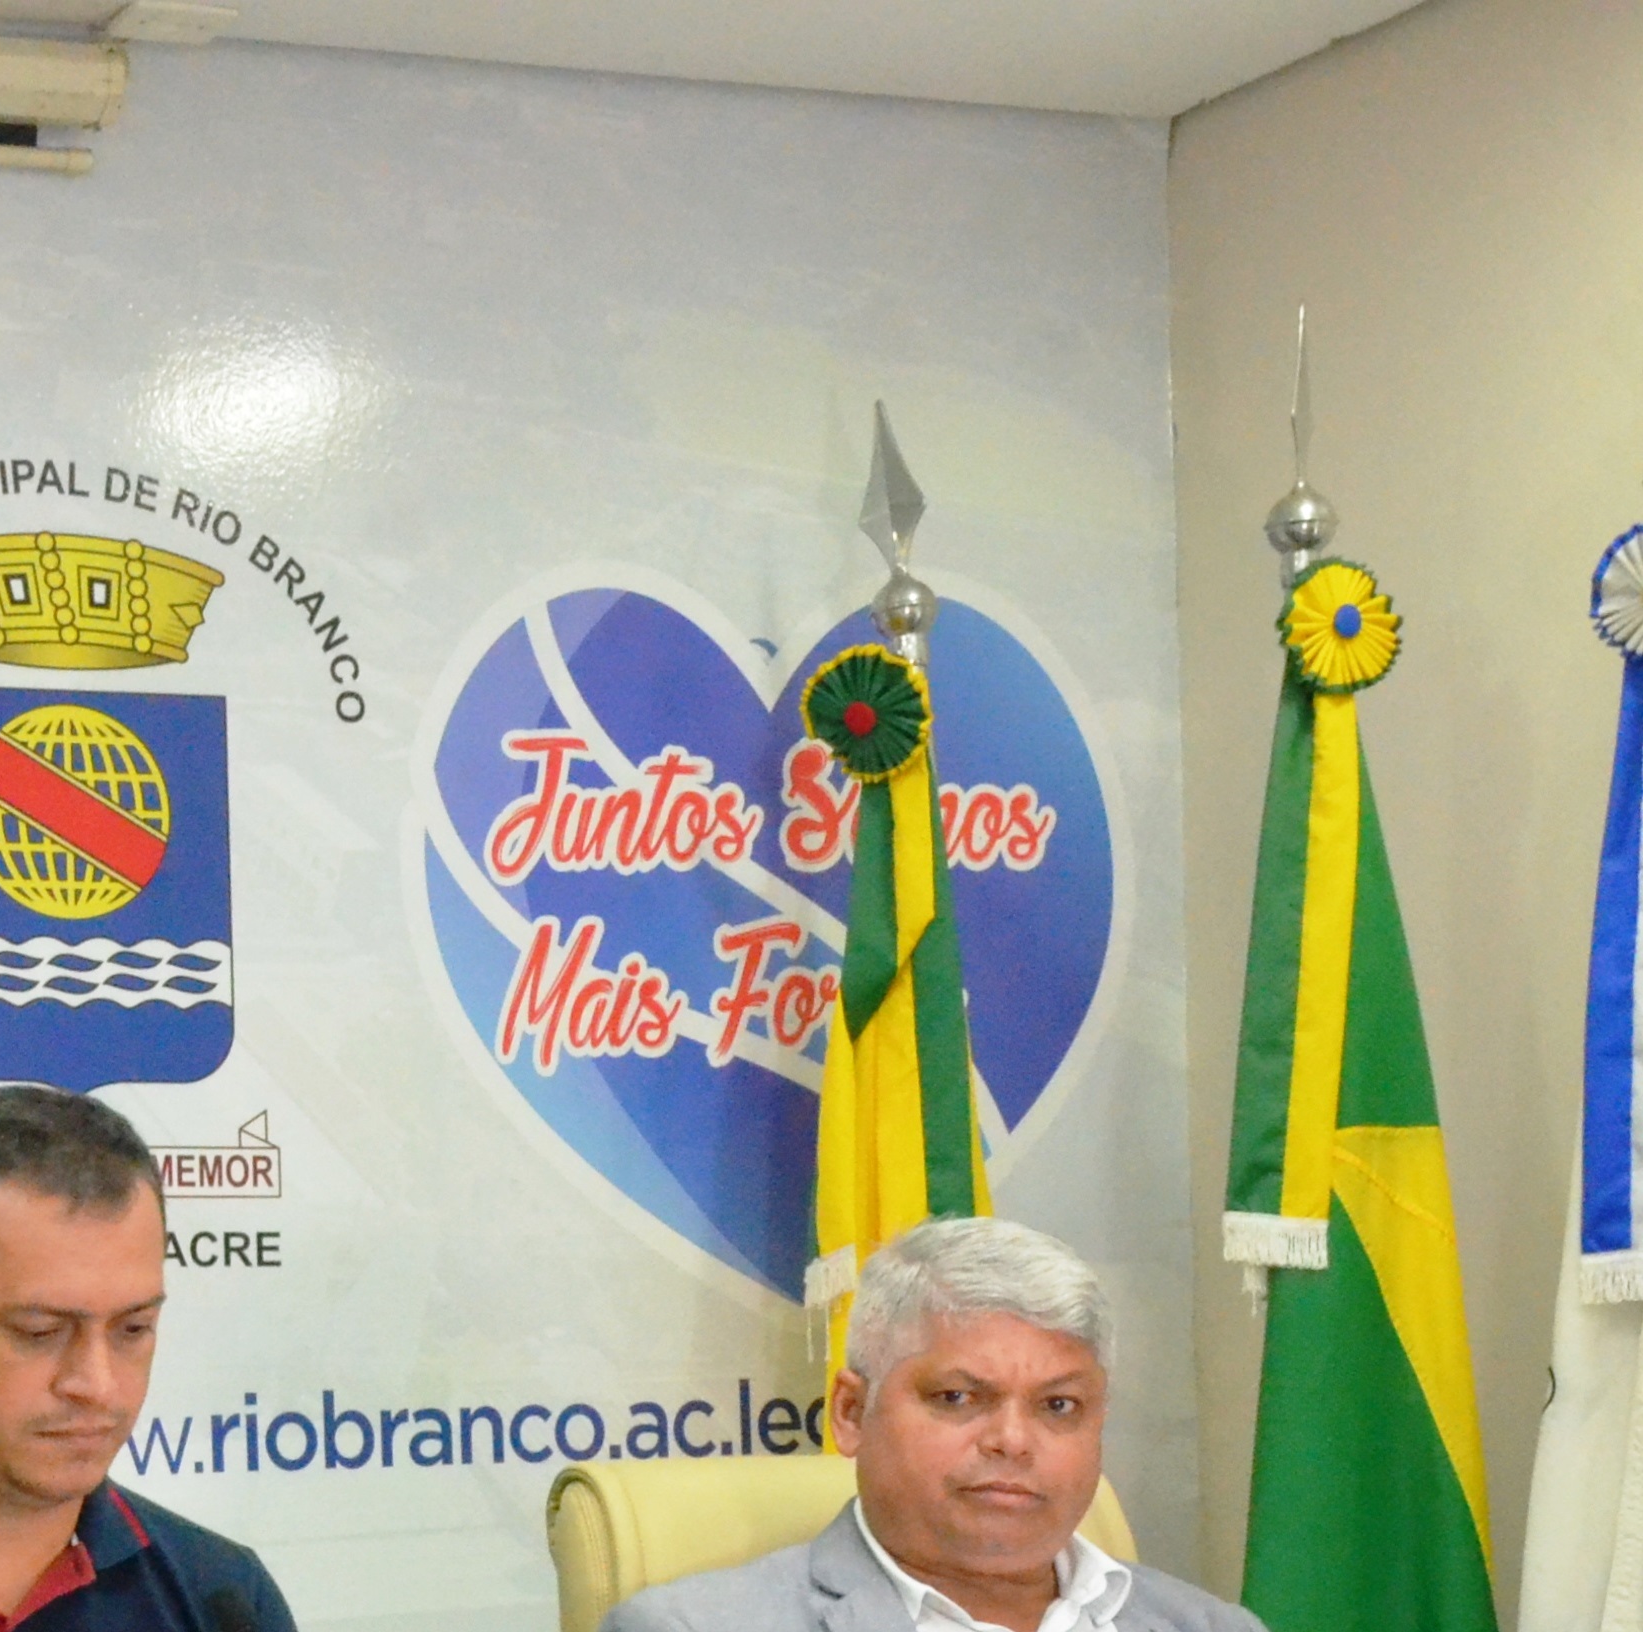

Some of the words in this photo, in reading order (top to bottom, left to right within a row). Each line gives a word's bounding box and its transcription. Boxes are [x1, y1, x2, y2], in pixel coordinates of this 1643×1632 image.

[104, 467, 159, 512] DE
[171, 488, 242, 545] RIO
[248, 534, 365, 723] BRANCO
[491, 736, 758, 877] Juntos
[502, 924, 682, 1068] Mais
[164, 1231, 282, 1268] ACRE
